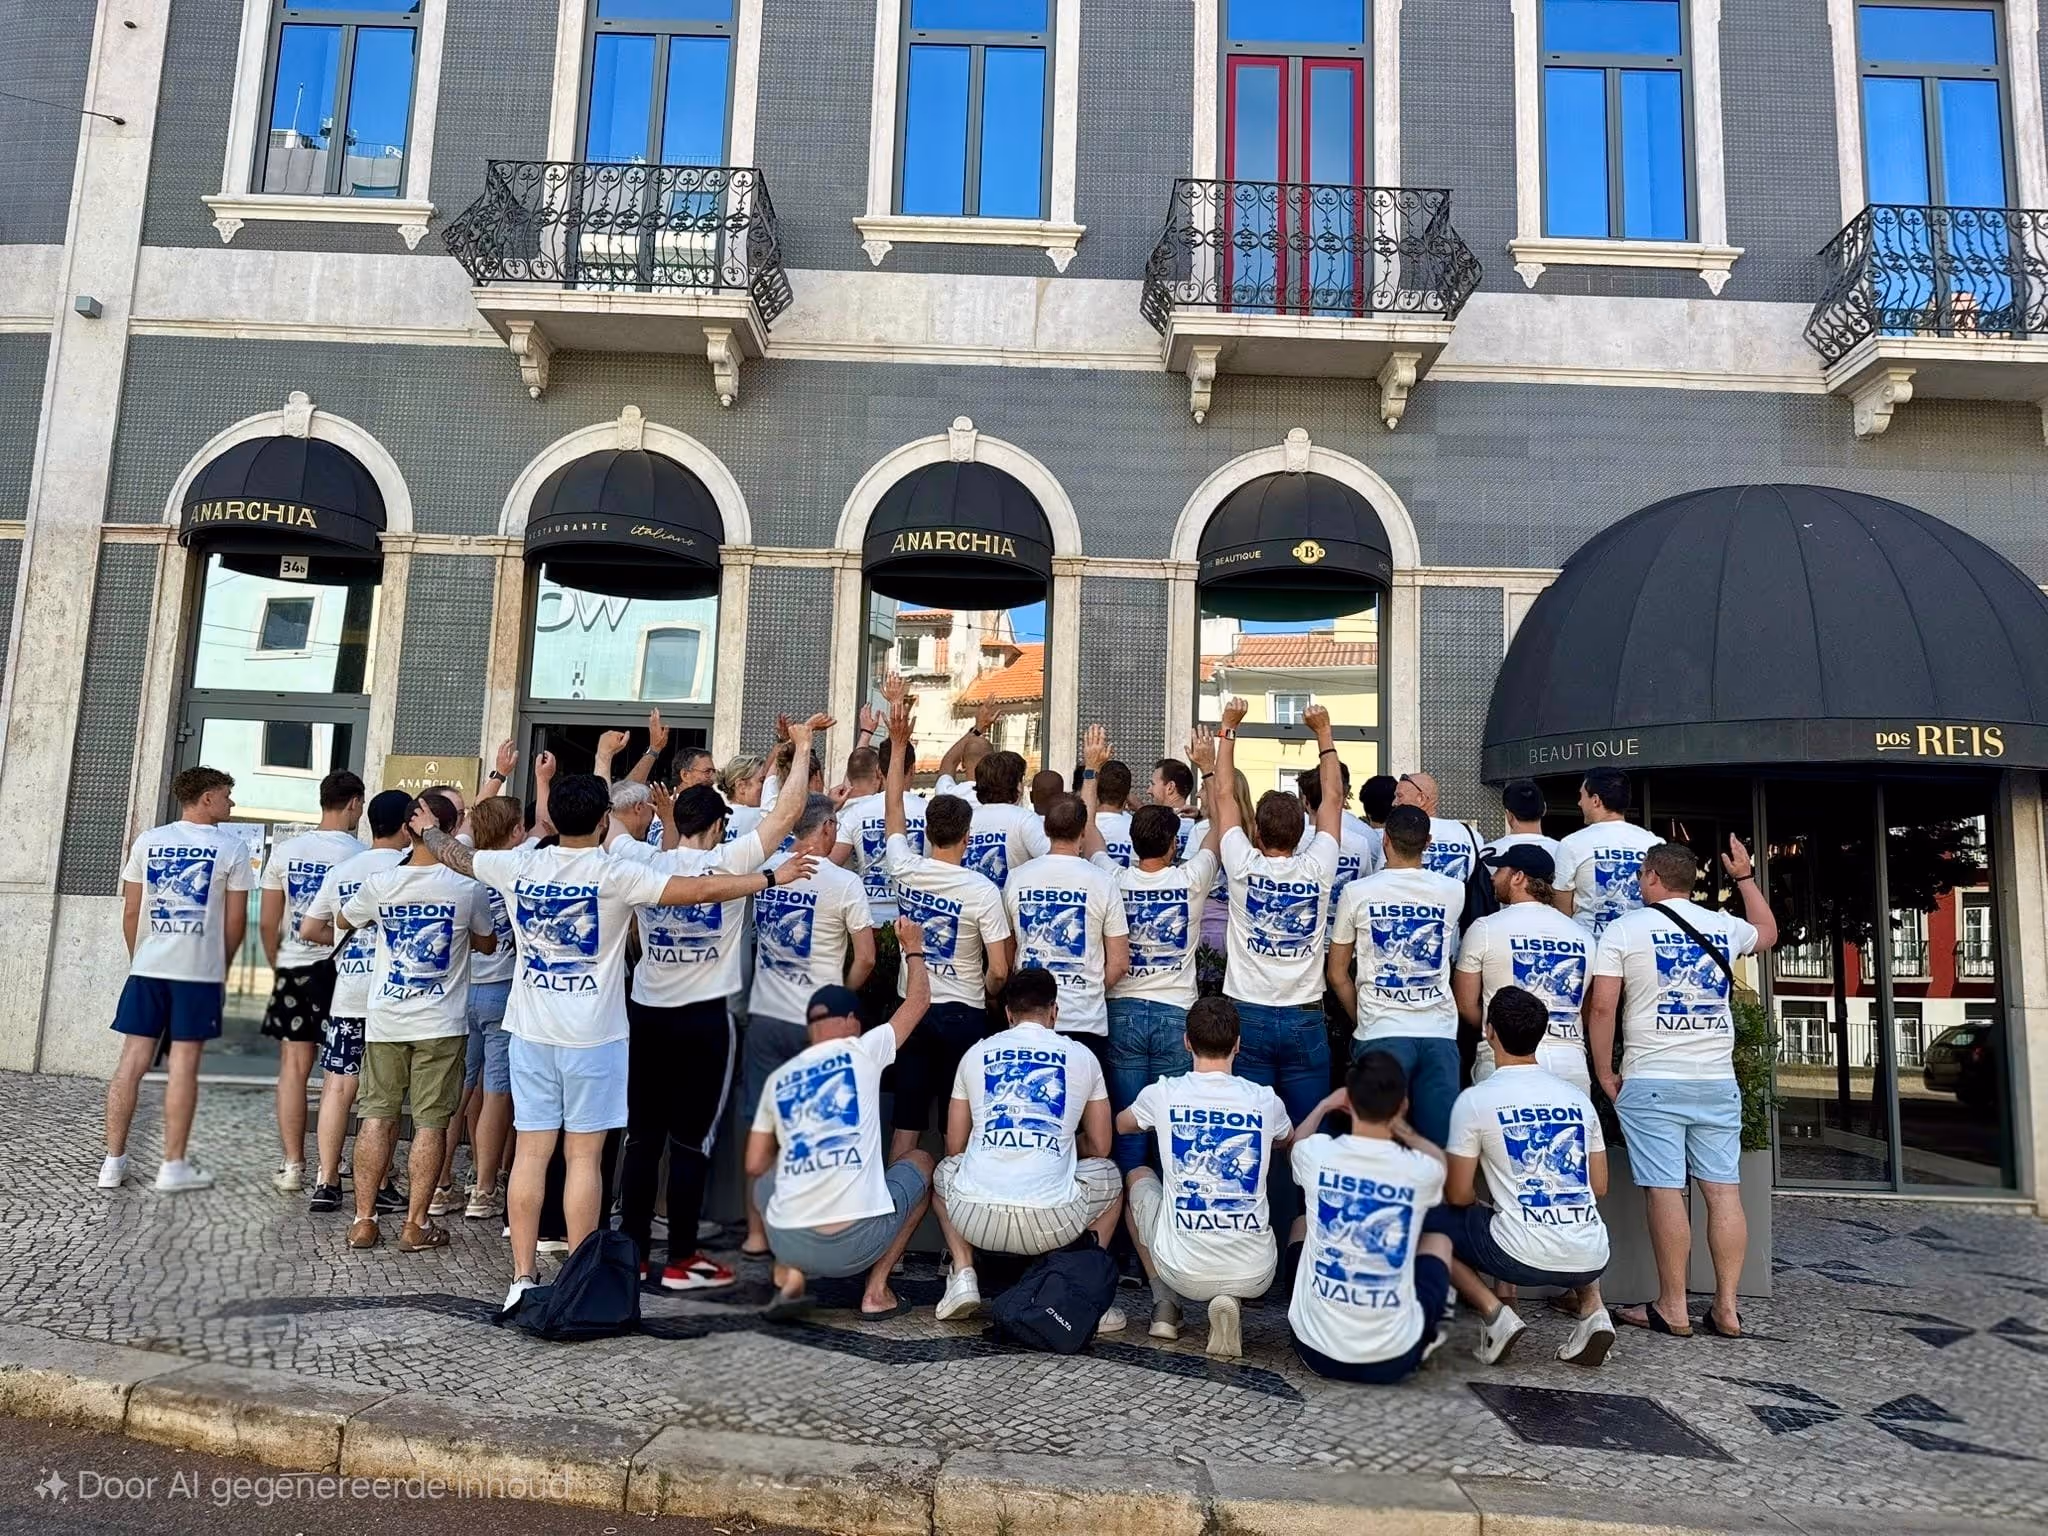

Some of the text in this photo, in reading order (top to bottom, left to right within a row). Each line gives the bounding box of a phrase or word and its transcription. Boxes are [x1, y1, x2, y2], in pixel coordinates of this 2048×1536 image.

[189, 500, 317, 528] ANARCHIA
[630, 524, 697, 547] italiano
[891, 531, 1016, 558] ANARCHIA
[1215, 550, 1262, 566] BEAUTIQUE
[282, 561, 306, 574] 34b
[1875, 725, 2005, 758] DOS REIS
[1528, 738, 1639, 764] BEAUTIQUE
[967, 832, 1007, 845] SBON
[147, 847, 218, 859] LISBON
[1424, 842, 1472, 855] SBON
[1594, 849, 1647, 861] LISBO
[288, 861, 335, 875] LISB
[338, 882, 362, 897] LIS
[514, 880, 599, 898] LISBON
[864, 886, 897, 898] NAL
[1247, 876, 1320, 895] LISBON
[898, 883, 963, 916] LISBON
[1019, 889, 1087, 904] LISBON
[378, 904, 456, 918] LISBON
[1369, 904, 1445, 920] LISBON
[151, 920, 205, 937] NALTA
[648, 946, 720, 963] NALTA
[1510, 938, 1586, 954] LISBON
[338, 960, 374, 974] NAL
[378, 982, 445, 1000] NAA
[1376, 985, 1443, 1003] NALTA
[1547, 1024, 1579, 1038] LTA
[1656, 1015, 1729, 1031] NALTA
[983, 1049, 1066, 1066] LISBON
[1169, 1108, 1263, 1129] LISBON
[1497, 1107, 1584, 1126] LISBON
[981, 1131, 1061, 1153] NALTA
[1318, 1171, 1415, 1203] LISBON
[1175, 1211, 1261, 1230] NALTA
[1522, 1204, 1599, 1226] NALTA
[1312, 1274, 1401, 1308] NALTA
